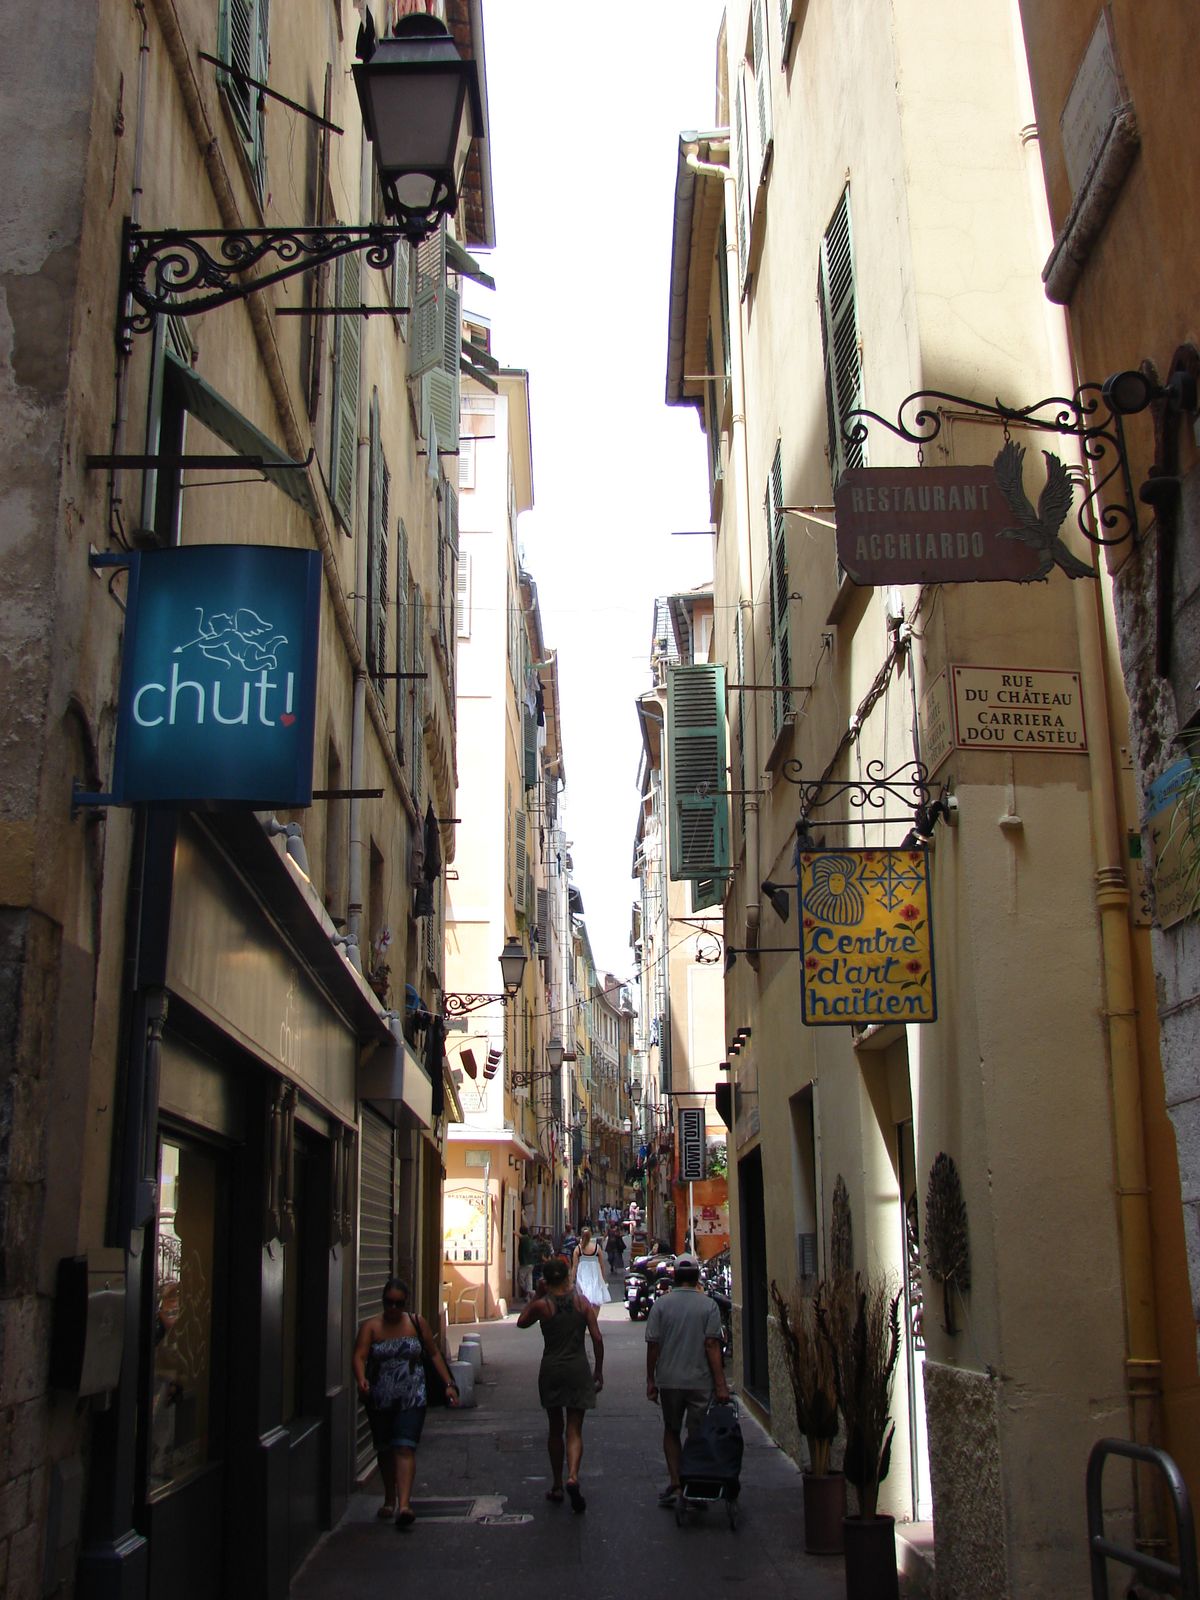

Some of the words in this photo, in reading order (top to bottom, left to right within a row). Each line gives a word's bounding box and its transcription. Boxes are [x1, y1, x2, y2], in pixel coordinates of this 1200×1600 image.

[851, 484, 990, 513] RESTAURANT
[855, 531, 985, 562] ACCHIARDO
[132, 662, 296, 727] chut!
[1001, 674, 1034, 688] RUE
[965, 689, 989, 702] DU
[996, 688, 1073, 706] CHÂTEAU
[977, 711, 1065, 728] CARRIERA
[1013, 727, 1078, 744] CASTÈU
[808, 927, 921, 955] Centre
[817, 956, 910, 985] d'art
[808, 988, 929, 1016] haïtien
